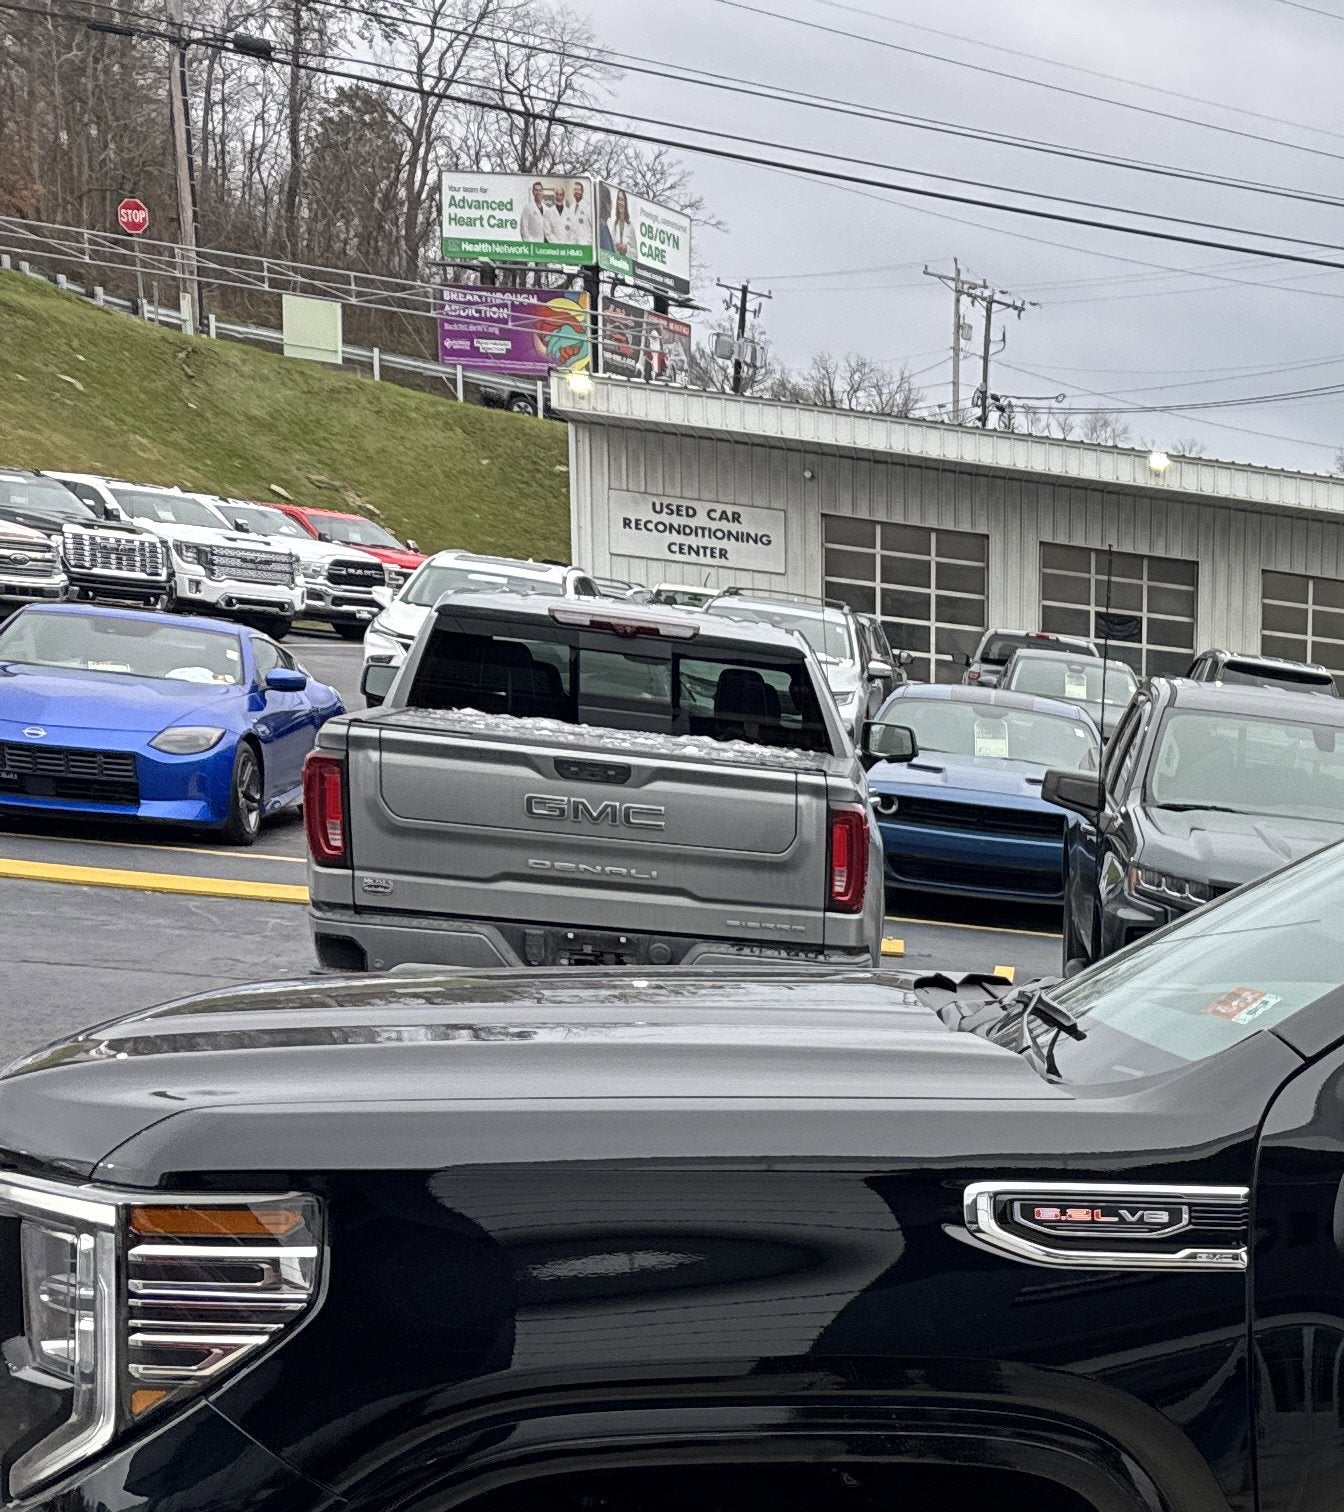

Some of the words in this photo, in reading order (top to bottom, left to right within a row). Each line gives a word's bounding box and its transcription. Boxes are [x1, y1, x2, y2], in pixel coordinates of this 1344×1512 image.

[447, 195, 514, 212] Advanced
[120, 208, 146, 223] STOP
[448, 212, 485, 228] Heart
[487, 215, 518, 230] Care
[640, 221, 680, 251] OB/GYN
[461, 241, 492, 253] Health
[493, 244, 530, 256] Network
[640, 241, 667, 265] CARE
[652, 501, 697, 518] USED
[706, 508, 742, 524] CAR
[622, 516, 772, 546] RECONDITIONING
[667, 541, 729, 560] CENTER
[524, 793, 665, 830] GMC
[527, 858, 658, 880] DENALI
